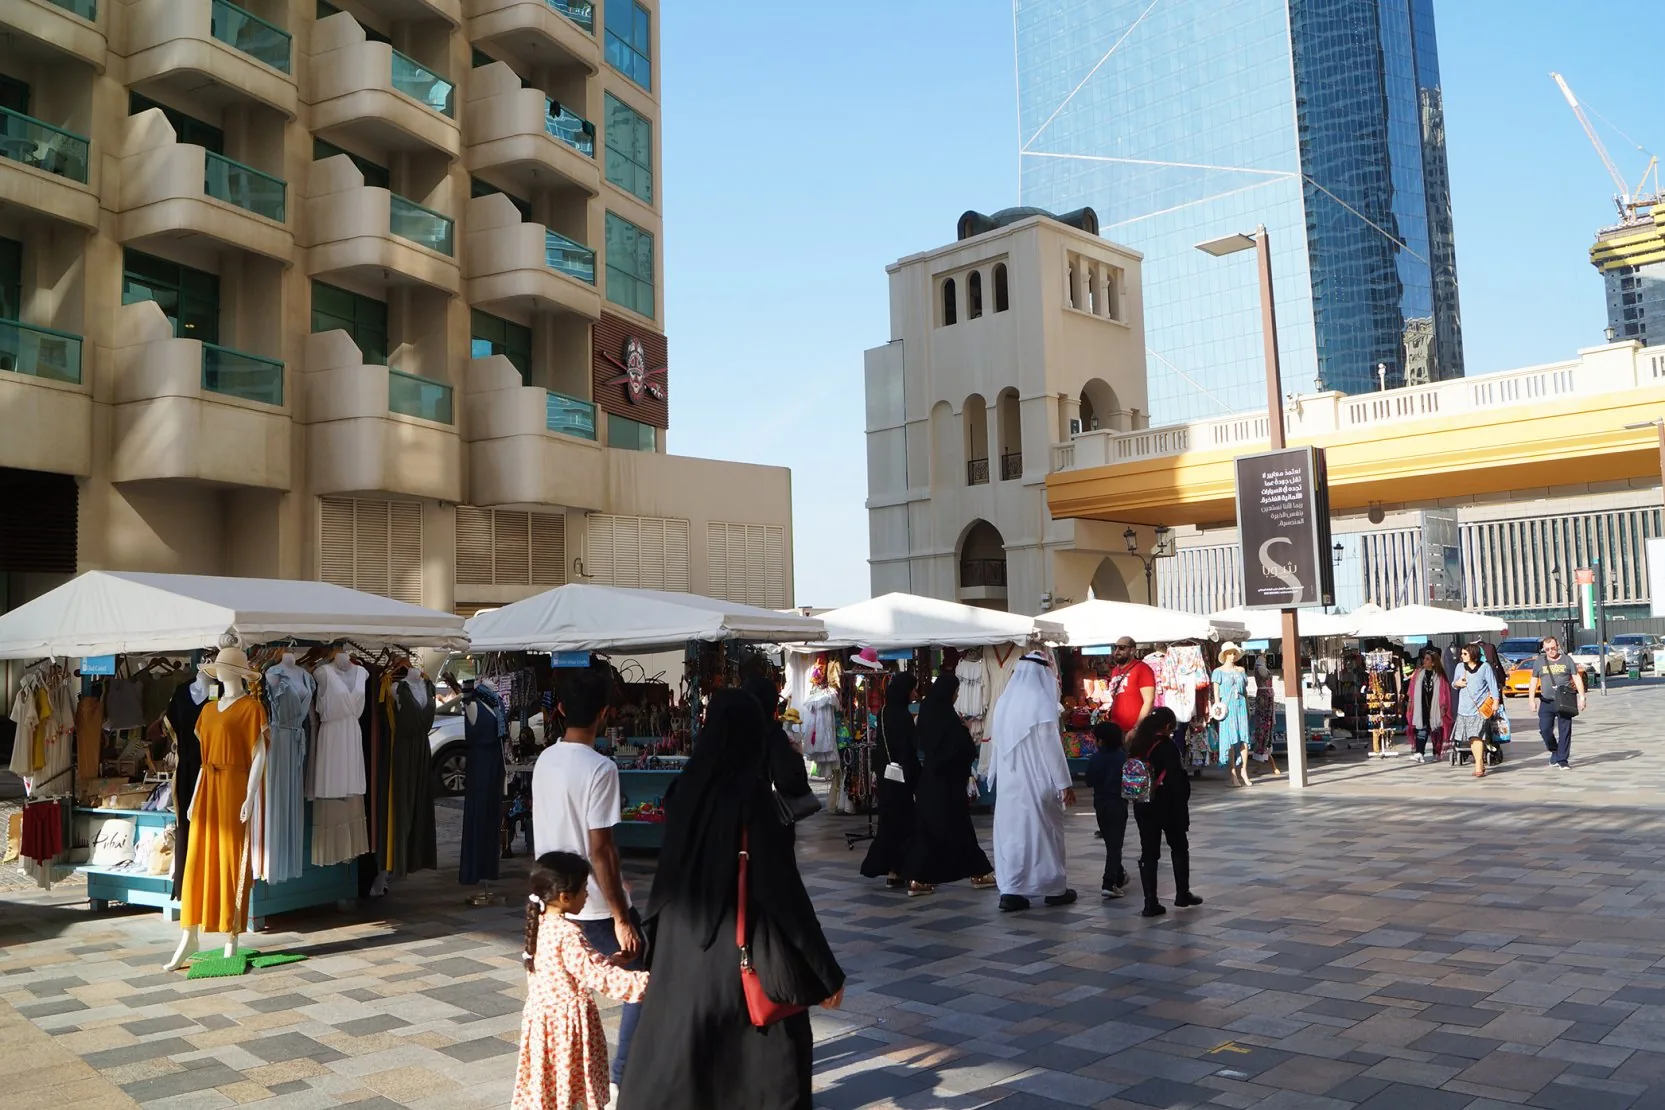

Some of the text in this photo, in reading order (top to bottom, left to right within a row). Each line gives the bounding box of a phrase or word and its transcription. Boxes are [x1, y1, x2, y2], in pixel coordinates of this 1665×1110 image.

[1261, 487, 1282, 495] السيارات
[1283, 485, 1288, 493] في
[1270, 511, 1286, 520] الخبرة
